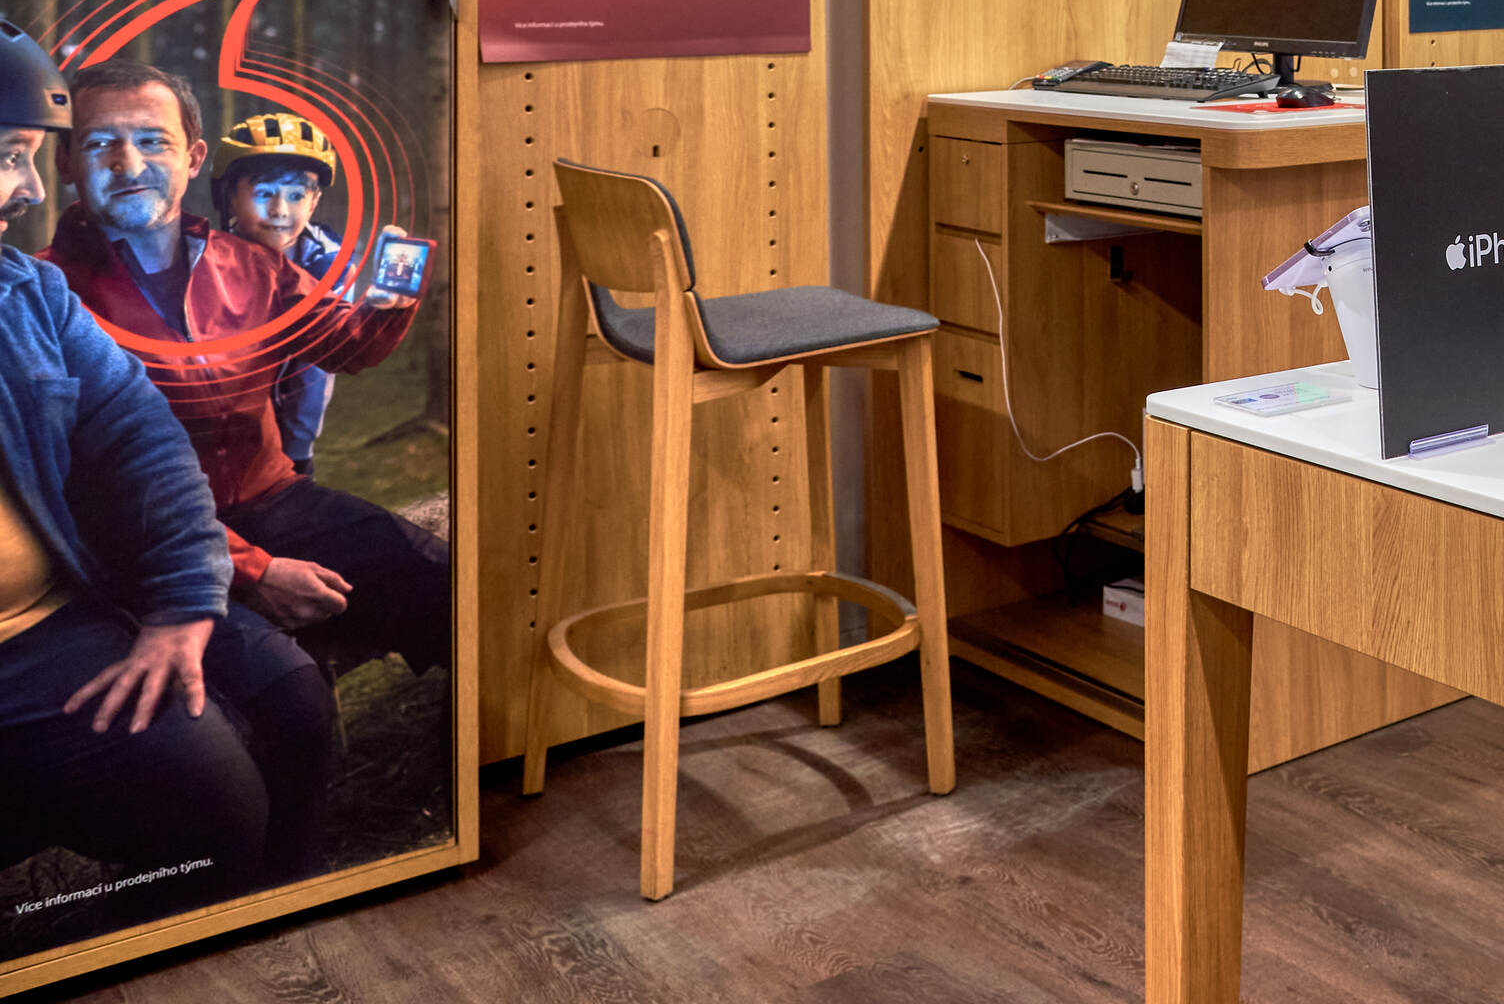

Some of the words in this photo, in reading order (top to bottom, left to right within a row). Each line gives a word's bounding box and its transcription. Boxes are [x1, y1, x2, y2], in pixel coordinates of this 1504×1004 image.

[15, 900, 44, 914] Více
[45, 883, 103, 908] informací
[104, 883, 113, 893] u
[115, 866, 178, 892] prodejního
[180, 857, 214, 875] týmu.
